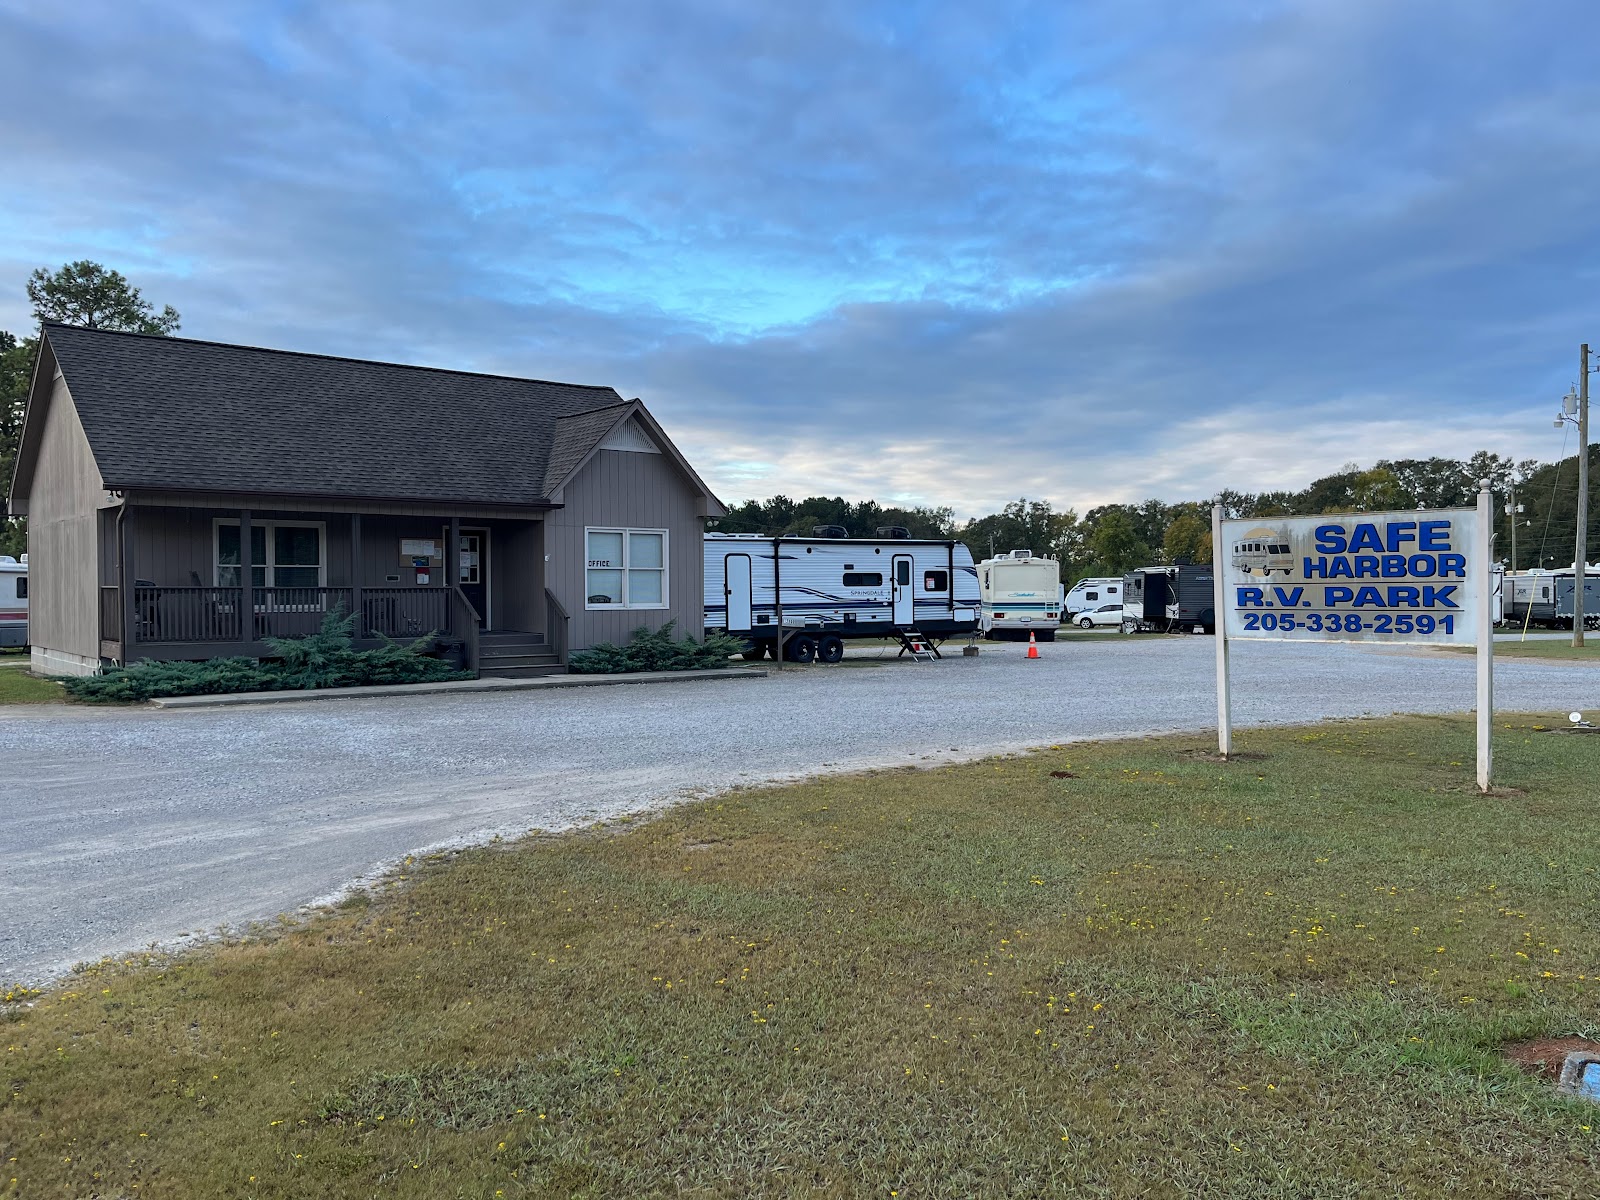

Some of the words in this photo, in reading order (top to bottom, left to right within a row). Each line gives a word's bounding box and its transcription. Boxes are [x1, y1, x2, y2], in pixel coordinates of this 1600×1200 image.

[1315, 521, 1451, 554] SAFE
[1303, 554, 1466, 579] HARBOR
[1236, 587, 1311, 607] R.V.
[1324, 586, 1460, 607] PARK
[1243, 613, 1454, 635] 205-338-2591
